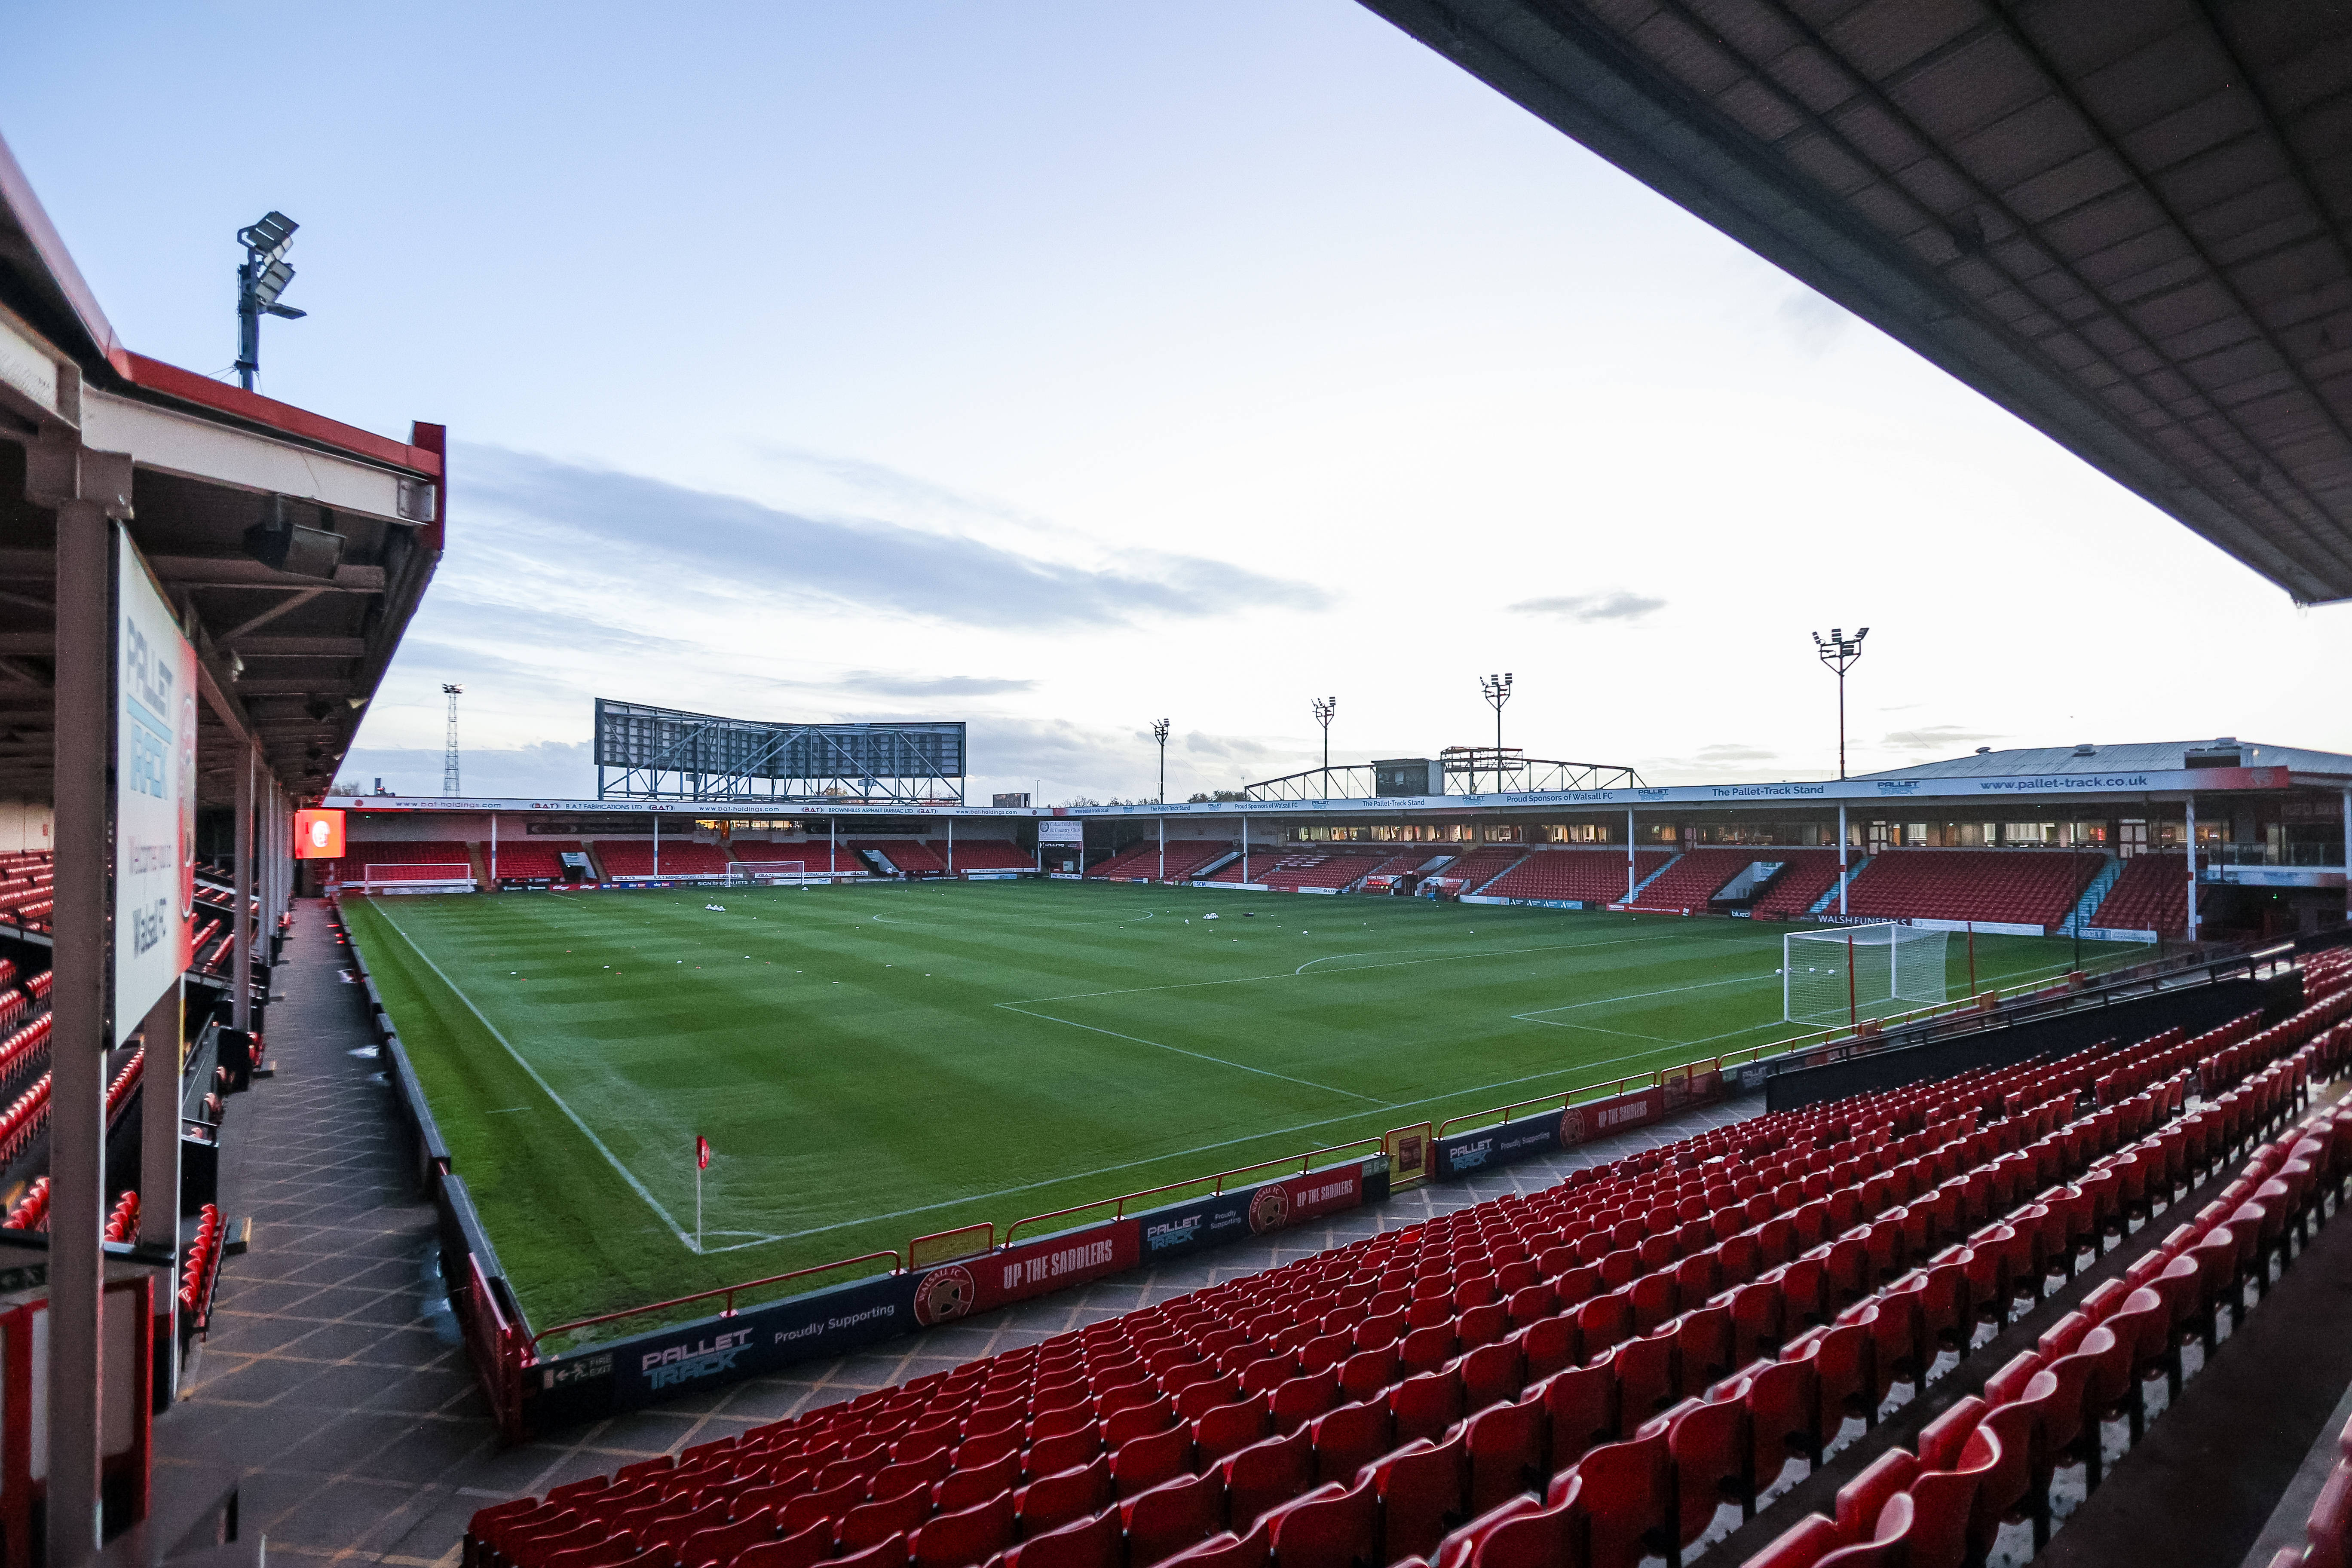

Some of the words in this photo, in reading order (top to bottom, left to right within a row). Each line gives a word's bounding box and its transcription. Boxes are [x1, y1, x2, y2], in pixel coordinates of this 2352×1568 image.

[128, 616, 172, 719] PALLET
[1712, 788, 1730, 796] The
[1733, 787, 1791, 796] Pallet-Track
[1794, 785, 1824, 794] Stand
[1981, 776, 2147, 790] www.pallet-track.co.uk
[1818, 915, 1852, 925] WALSH
[1450, 1138, 1492, 1158] PALLET
[1501, 1139, 1521, 1150] Proudly
[1522, 1131, 1550, 1146] Supporting
[1253, 1187, 1271, 1213] WALSALL
[1297, 1191, 1306, 1207] UP
[1308, 1188, 1319, 1204] THE
[1321, 1179, 1353, 1200] SADDLERS
[1147, 1215, 1202, 1238] PALLET
[1210, 1216, 1241, 1230] Supporting
[1215, 1210, 1236, 1221] Proudly
[1147, 1225, 1201, 1250] TRACK
[1004, 1262, 1022, 1289] UP
[1026, 1255, 1048, 1283] THE
[1051, 1239, 1112, 1276] SADDLERS
[918, 1268, 949, 1302] WALSALL
[774, 1321, 825, 1344] Proudly
[828, 1304, 894, 1329] Supporting
[642, 1327, 753, 1371] PALLET
[643, 1343, 753, 1390] TRACK
